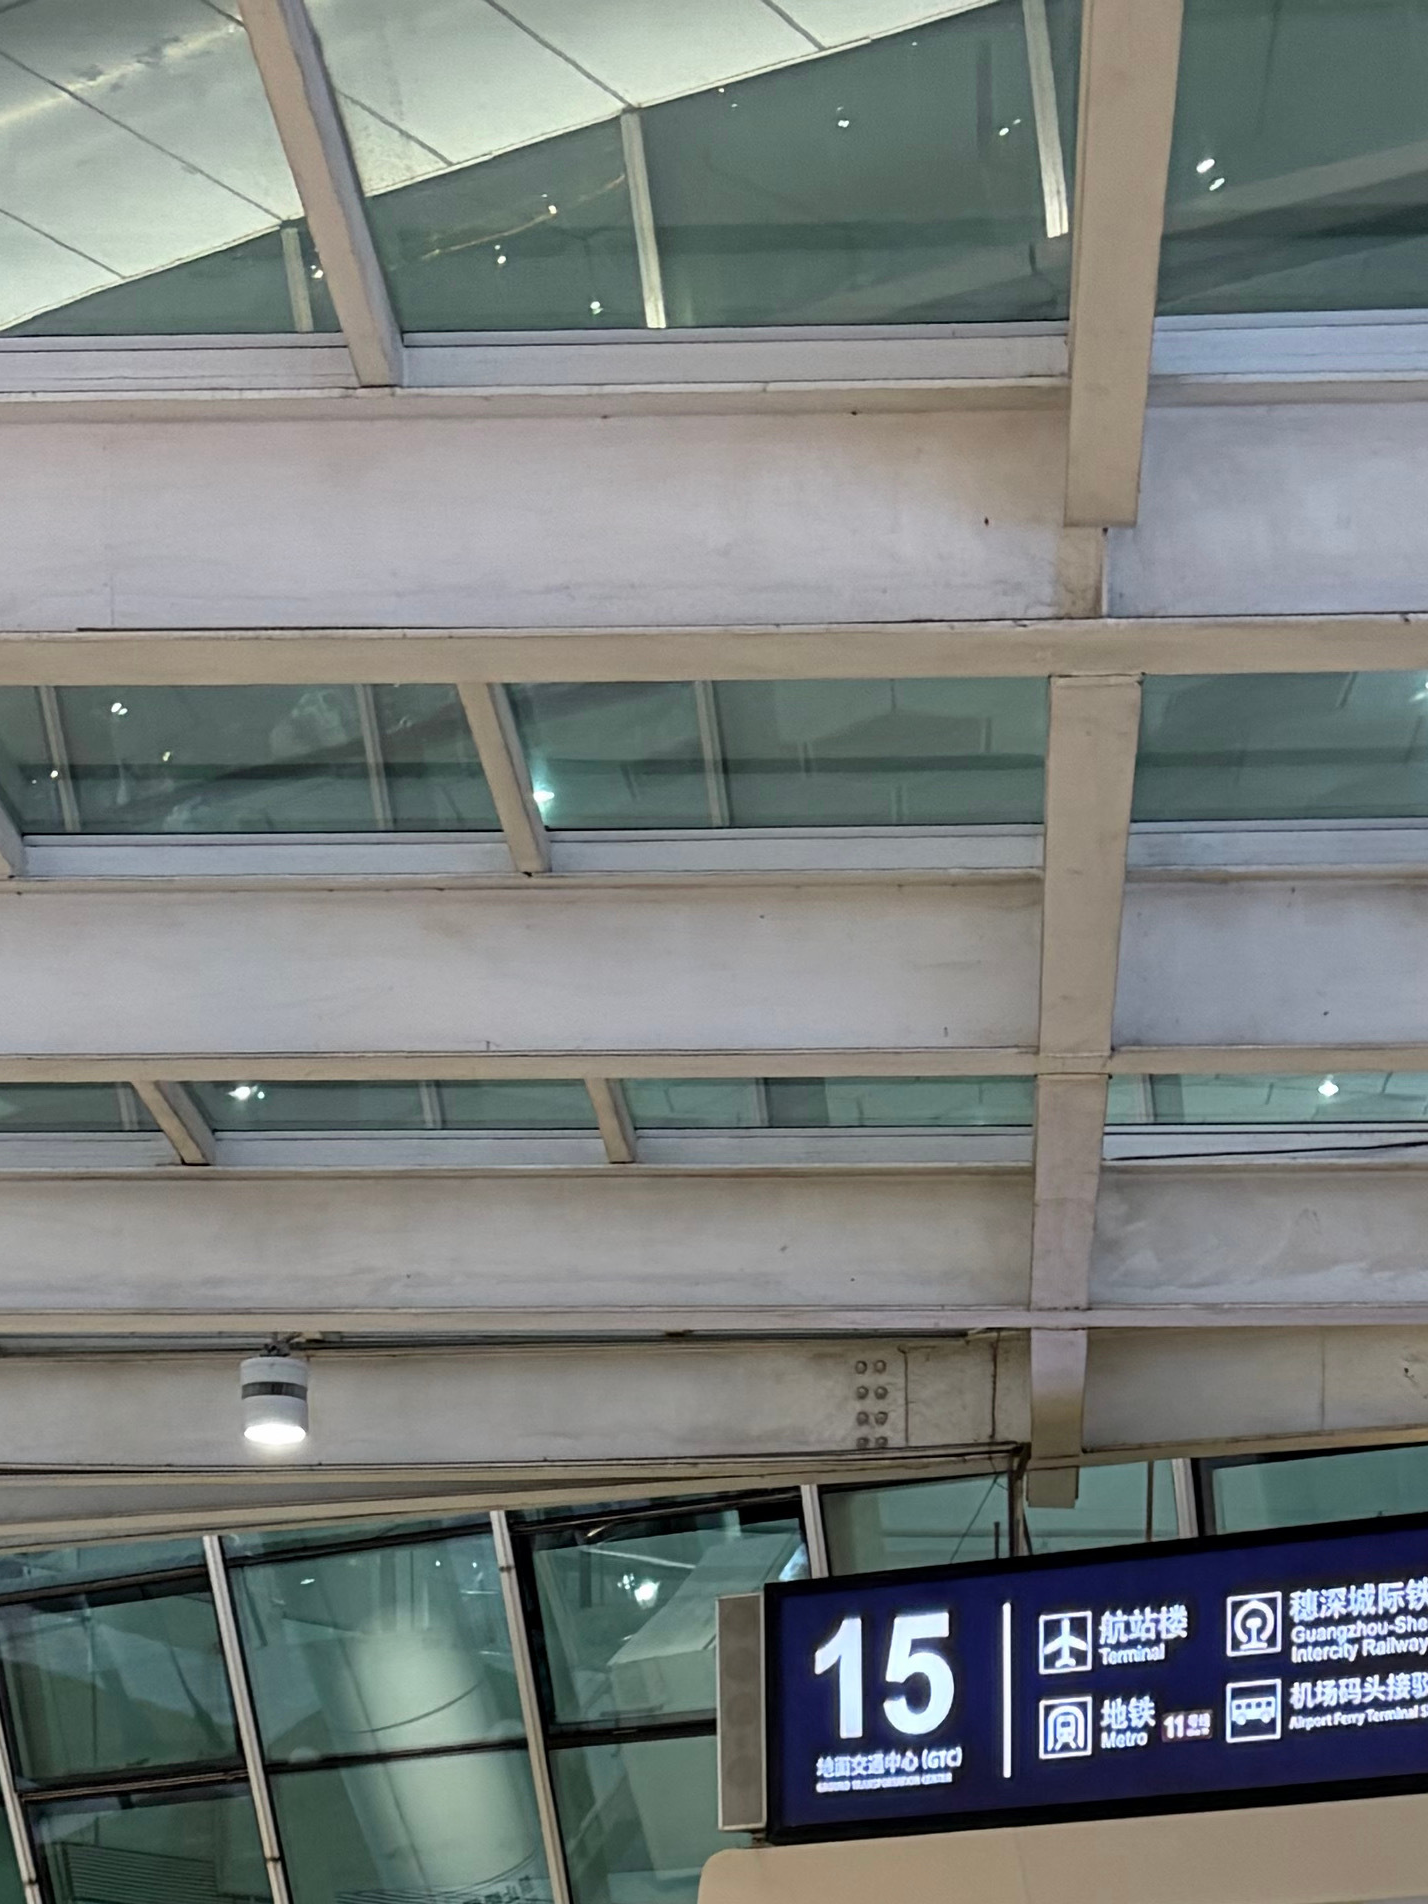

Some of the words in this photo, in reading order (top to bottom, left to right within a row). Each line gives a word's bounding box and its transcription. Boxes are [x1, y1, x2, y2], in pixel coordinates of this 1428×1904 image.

[1099, 1605, 1188, 1645] 航站楼
[1099, 1644, 1165, 1666] Terminal
[1291, 1641, 1360, 1663] Intercity
[814, 1612, 954, 1739] 15
[1100, 1695, 1155, 1729] 地铁
[1289, 1714, 1332, 1731] Airport
[1334, 1710, 1365, 1727] Ferry
[1365, 1705, 1419, 1723] Terminal
[1101, 1731, 1148, 1749] Metro
